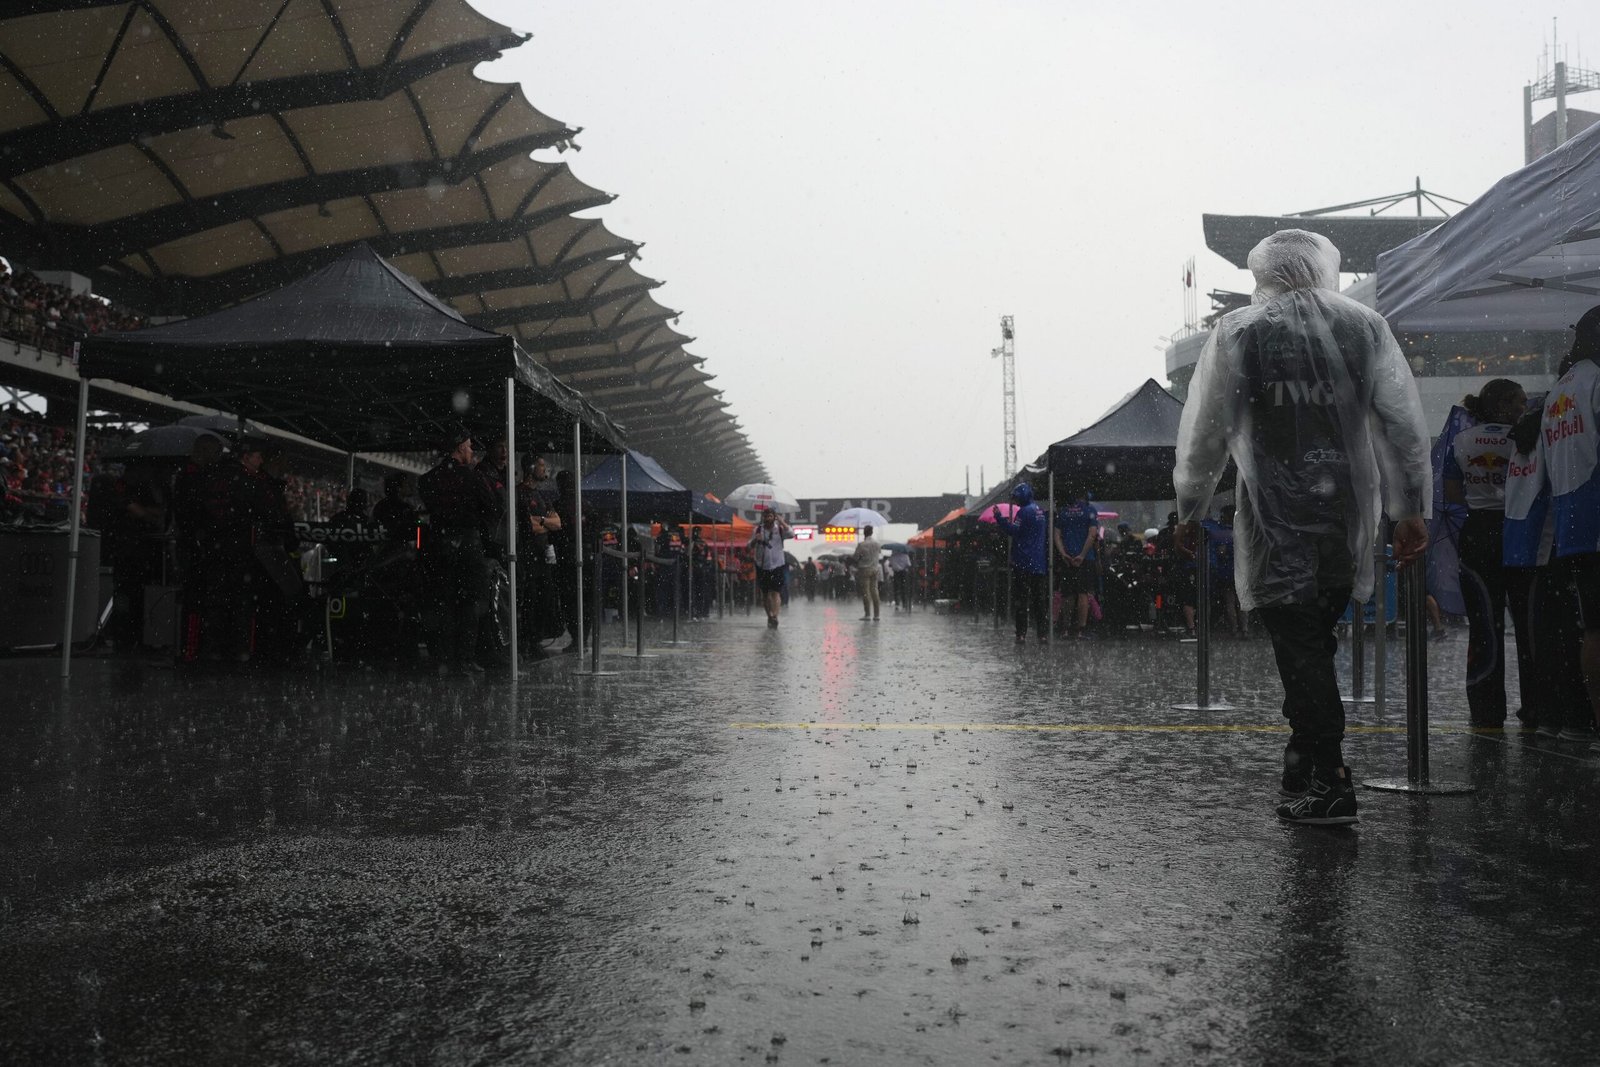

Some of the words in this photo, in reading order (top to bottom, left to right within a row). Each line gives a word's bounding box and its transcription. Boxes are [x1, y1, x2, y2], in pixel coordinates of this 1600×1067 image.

[1475, 437, 1507, 446] HUGO
[1465, 472, 1489, 484] Red
[293, 522, 391, 542] Revolut
